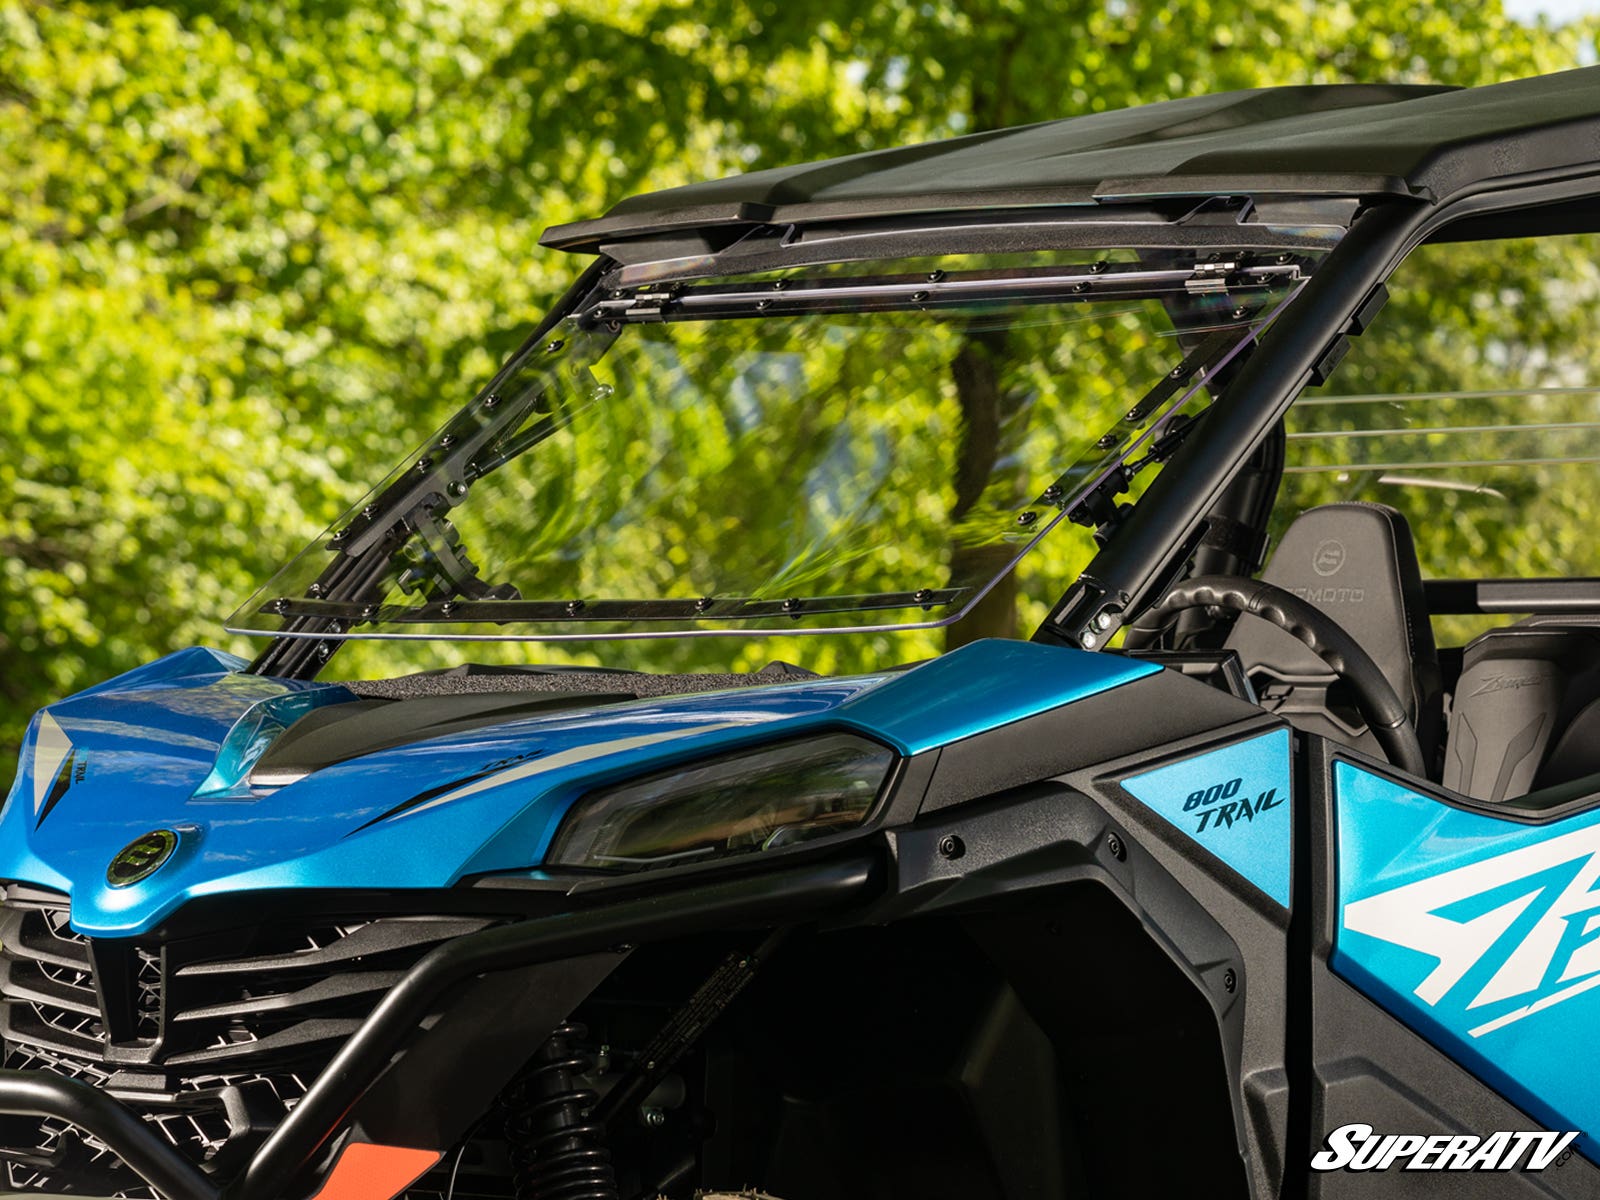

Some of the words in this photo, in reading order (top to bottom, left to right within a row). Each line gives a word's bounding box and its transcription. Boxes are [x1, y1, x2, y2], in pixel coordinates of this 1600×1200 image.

[1287, 587, 1365, 602] FMOTO
[1182, 777, 1243, 812] 800
[1195, 787, 1286, 833] TRAIL
